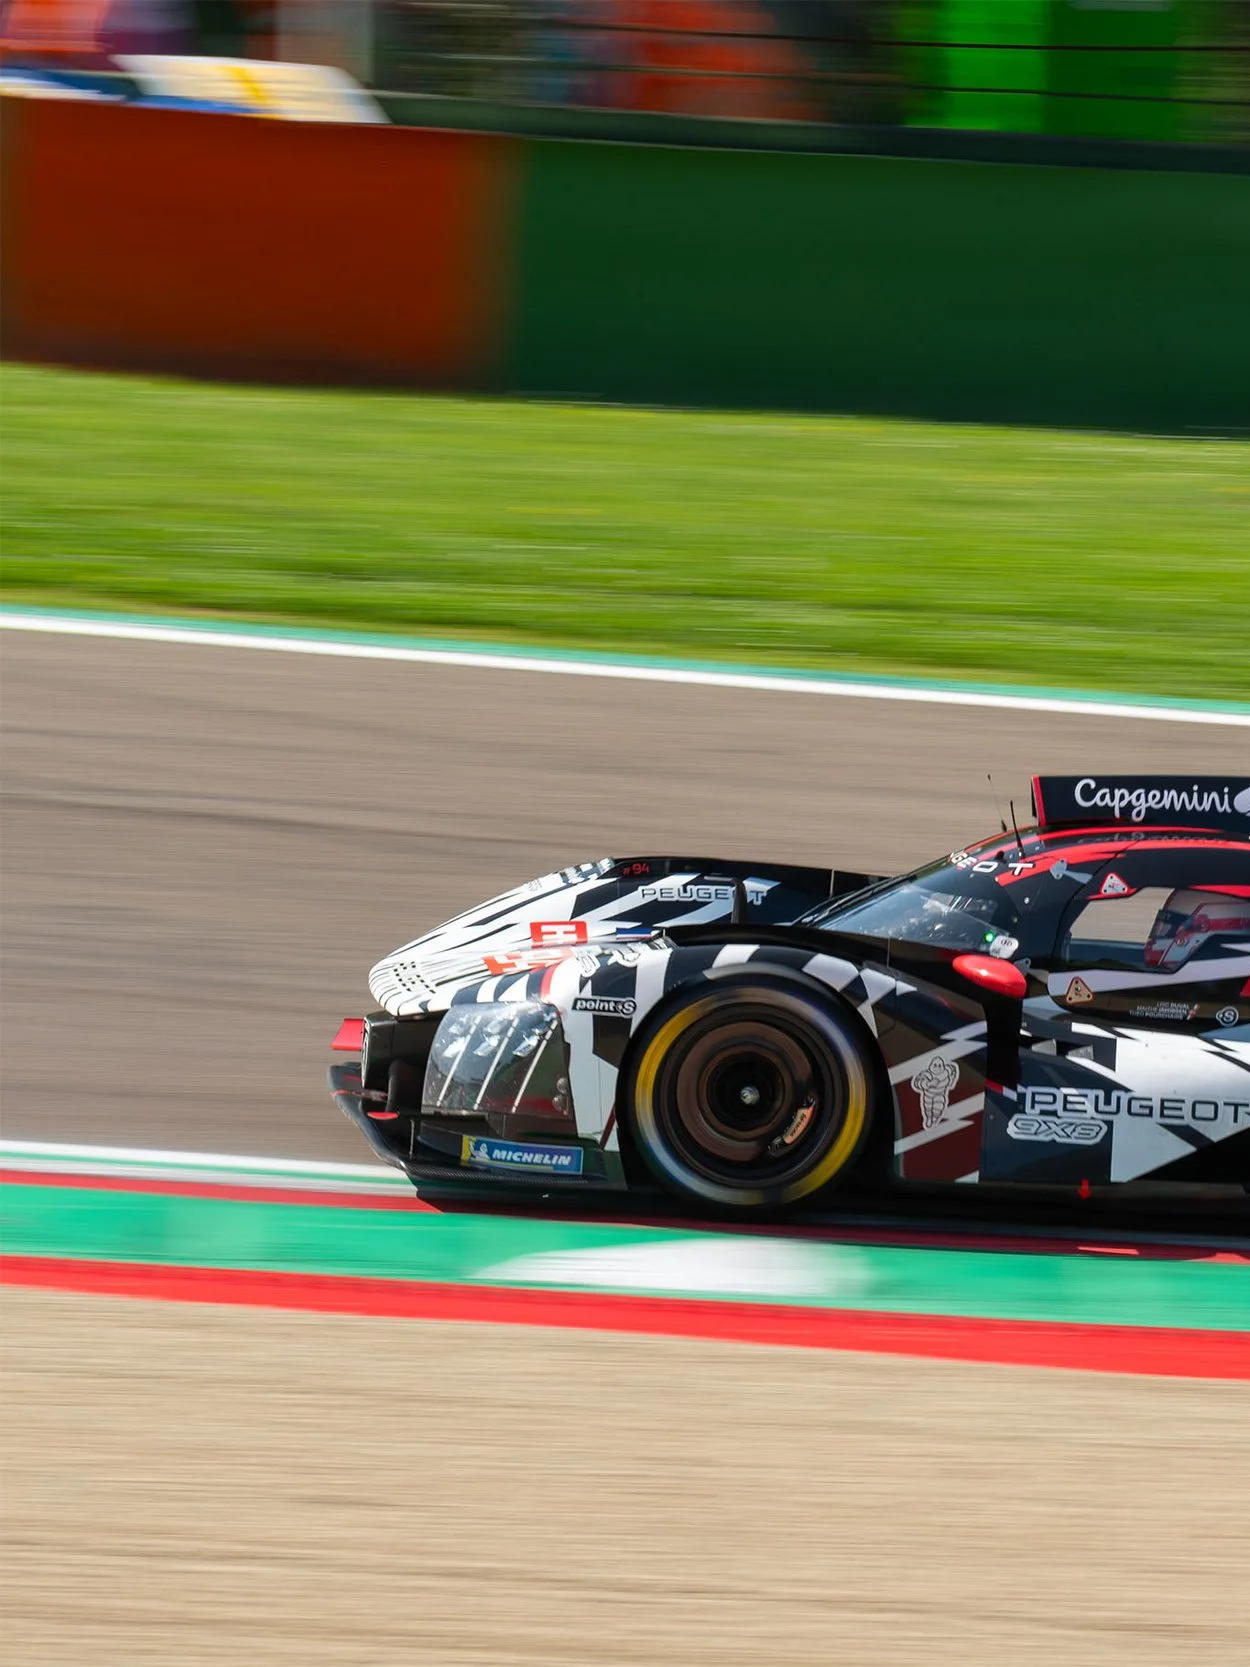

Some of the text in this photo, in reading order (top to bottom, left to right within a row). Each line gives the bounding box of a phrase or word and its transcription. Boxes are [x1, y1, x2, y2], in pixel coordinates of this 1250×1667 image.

[1074, 778, 1232, 822] Capgemini
[639, 886, 766, 905] PEUGET
[574, 998, 616, 1013] point
[1029, 1087, 1250, 1124] PEUGEOT
[1012, 1117, 1103, 1140] 9X8
[491, 1148, 572, 1166] MICHELIN
